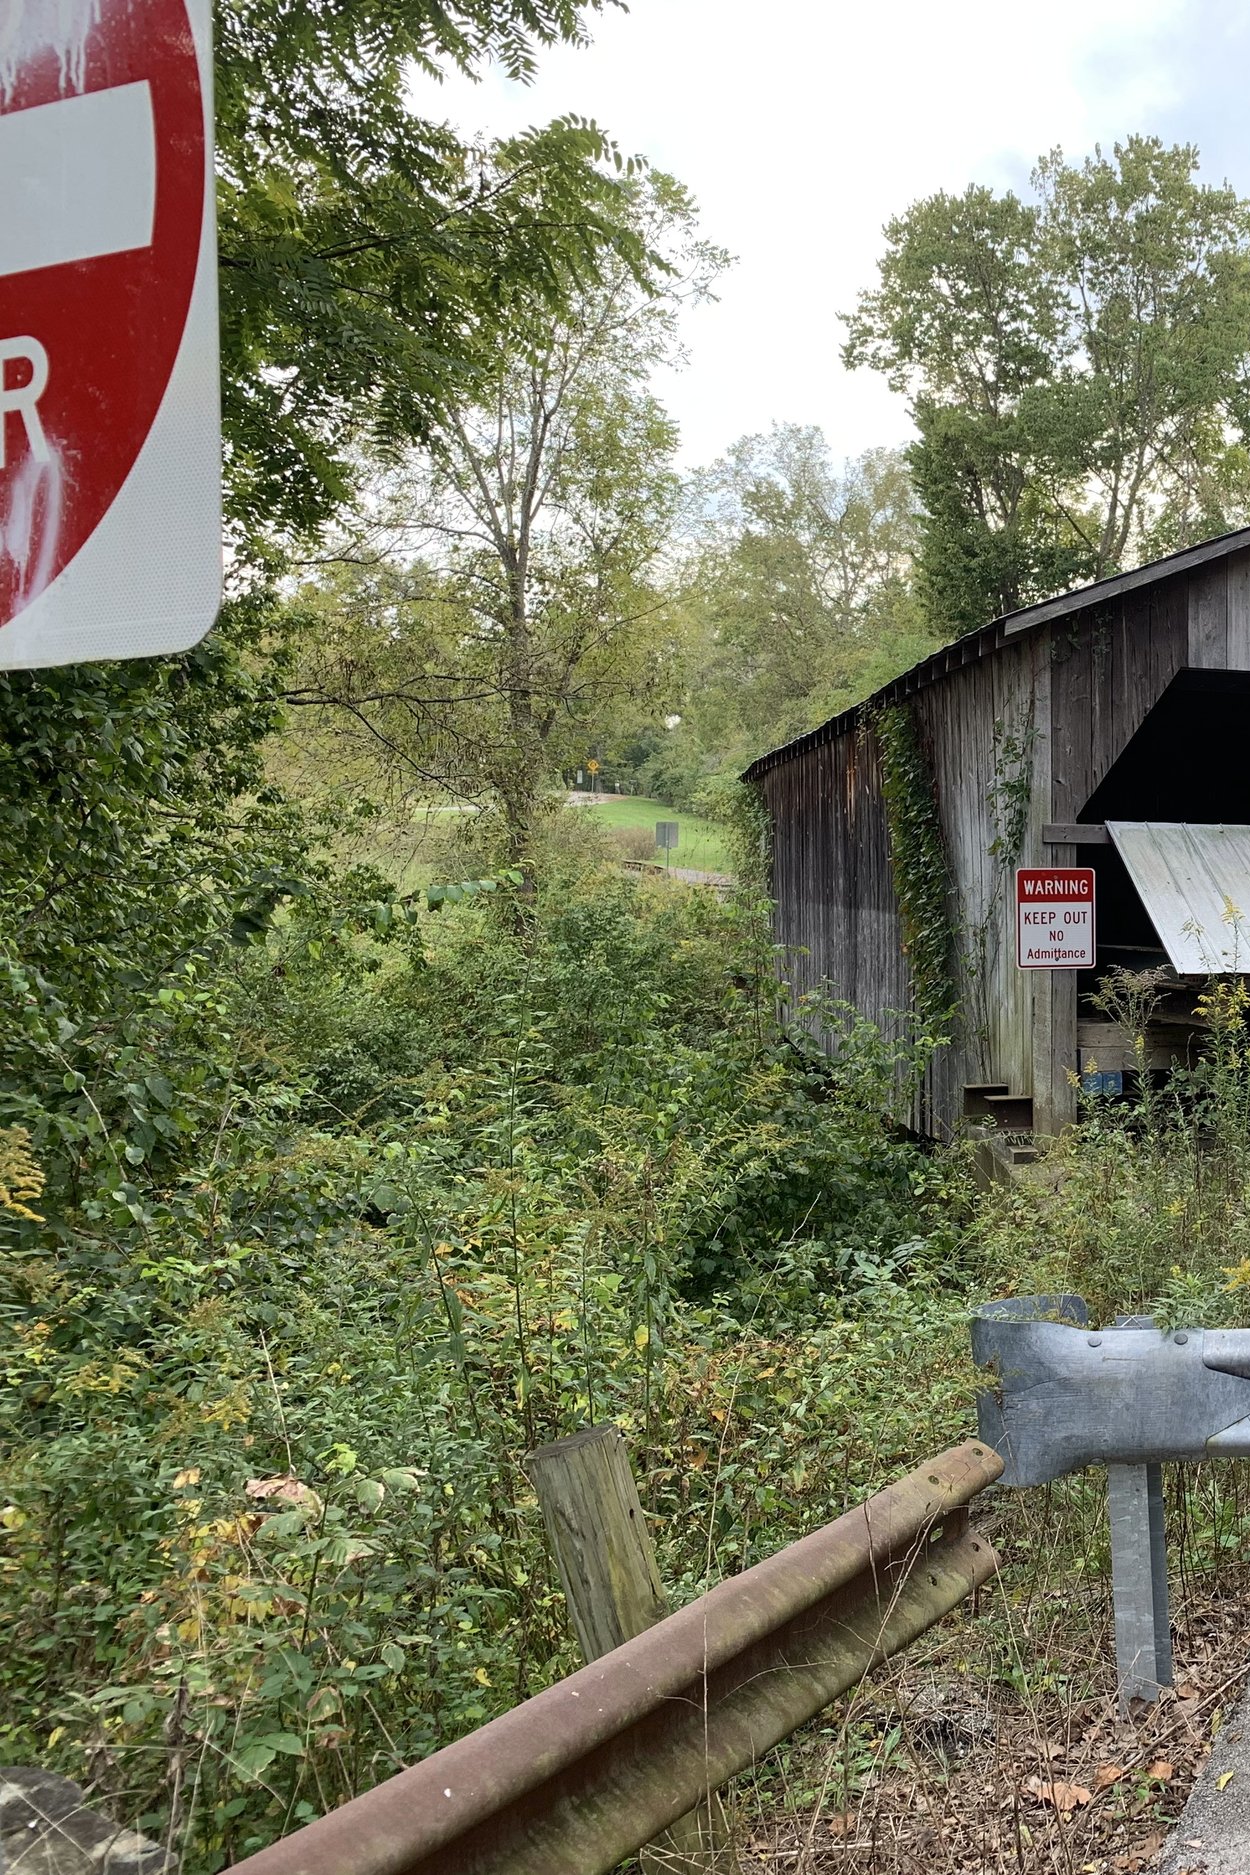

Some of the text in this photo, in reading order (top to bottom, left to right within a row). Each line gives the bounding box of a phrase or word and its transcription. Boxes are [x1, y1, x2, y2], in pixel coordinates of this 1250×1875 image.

[1023, 880, 1088, 895] WARNING
[1024, 911, 1088, 925] KEEP OUT
[1049, 930, 1064, 941] NO
[1027, 948, 1086, 960] Admittance
